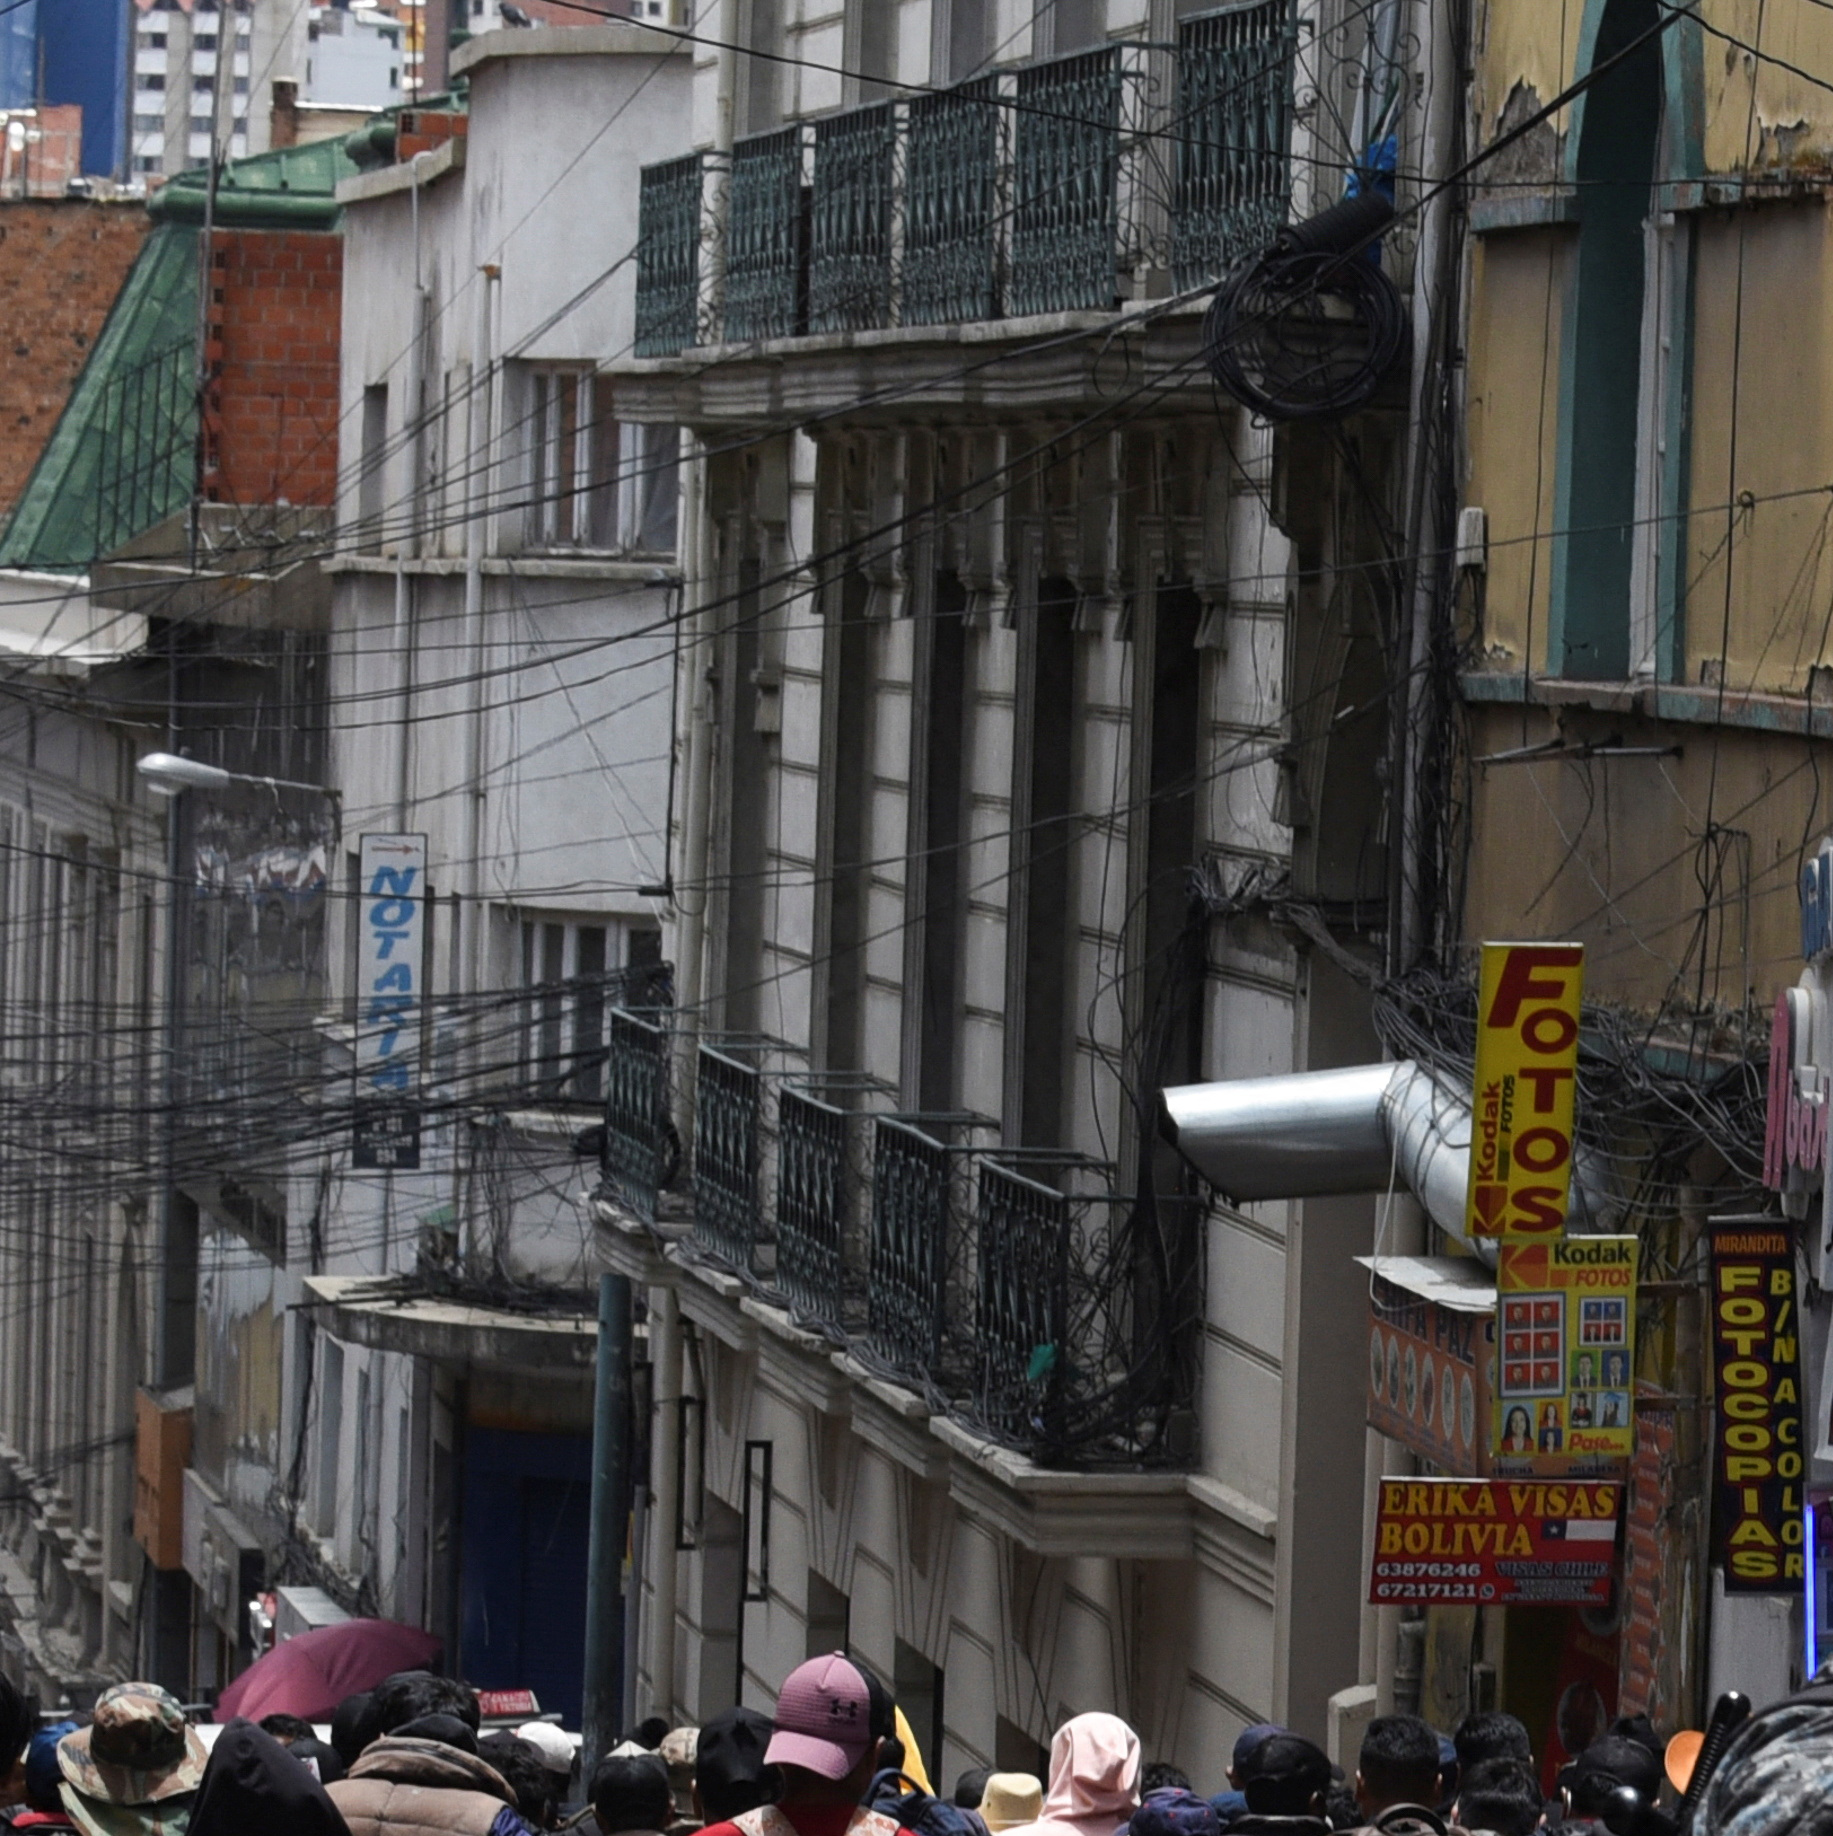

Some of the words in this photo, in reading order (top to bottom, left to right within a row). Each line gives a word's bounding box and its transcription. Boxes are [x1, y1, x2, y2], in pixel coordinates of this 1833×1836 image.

[1487, 948, 1583, 1233] FOTOS
[1500, 1074, 1515, 1134] FOTOS
[1475, 1080, 1501, 1183] Kodak
[1554, 1242, 1633, 1265] Kodak
[1714, 1233, 1788, 1255] MIRANDITA
[1574, 1268, 1632, 1288] FOTOS
[1718, 1265, 1779, 1578] FOTOCOPIAS
[1382, 1483, 1497, 1516] ERIKA
[1508, 1485, 1616, 1518] VISAS
[1777, 1416, 1805, 1579] COLOR
[1378, 1522, 1534, 1556] BOLIVIA
[1376, 1562, 1482, 1578] 63876246
[1377, 1582, 1477, 1599] 67217121
